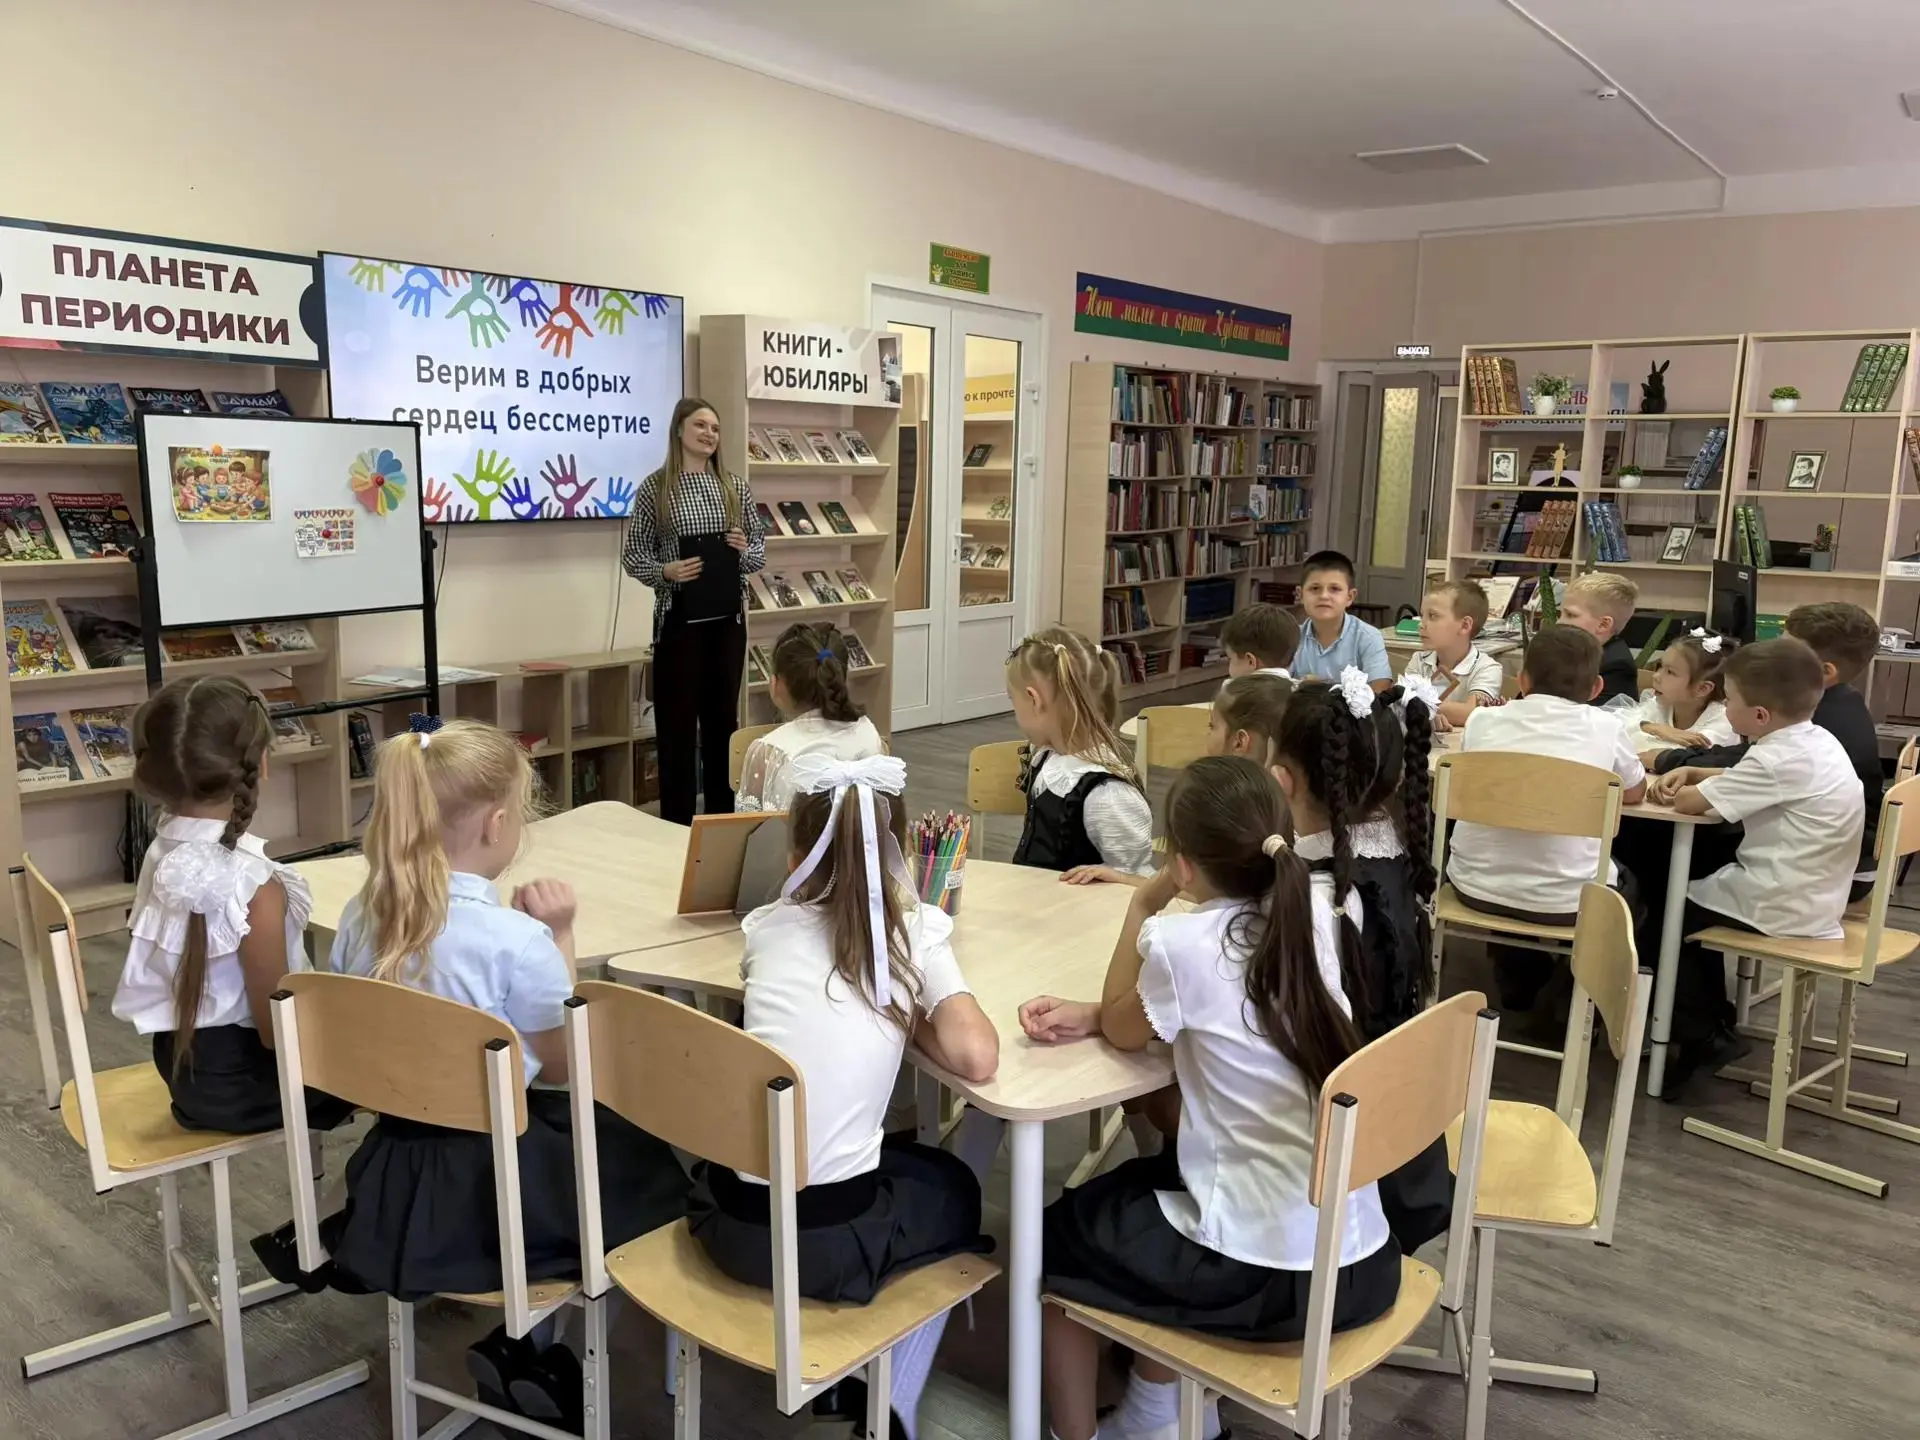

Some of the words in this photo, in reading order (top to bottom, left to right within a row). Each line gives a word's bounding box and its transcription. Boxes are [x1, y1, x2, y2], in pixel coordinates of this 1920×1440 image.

[53, 244, 259, 296] ПЛАНЕТА
[21, 293, 290, 346] ПЕРИОДИКИ
[1085, 284, 1113, 319] Нет
[1120, 303, 1155, 325] милее
[1161, 313, 1168, 327] и
[1174, 313, 1207, 337] краше
[1213, 309, 1250, 348] Кубани
[763, 330, 832, 359] КНИГИ
[1397, 346, 1430, 355] ВЫХОД
[415, 354, 506, 392] Верим
[516, 369, 530, 389] в
[539, 365, 632, 398] добрых
[764, 365, 868, 394] ЮБИЛЯРЫ
[972, 392, 979, 401] к
[393, 407, 497, 436] сердец
[507, 404, 651, 439] бессмертие
